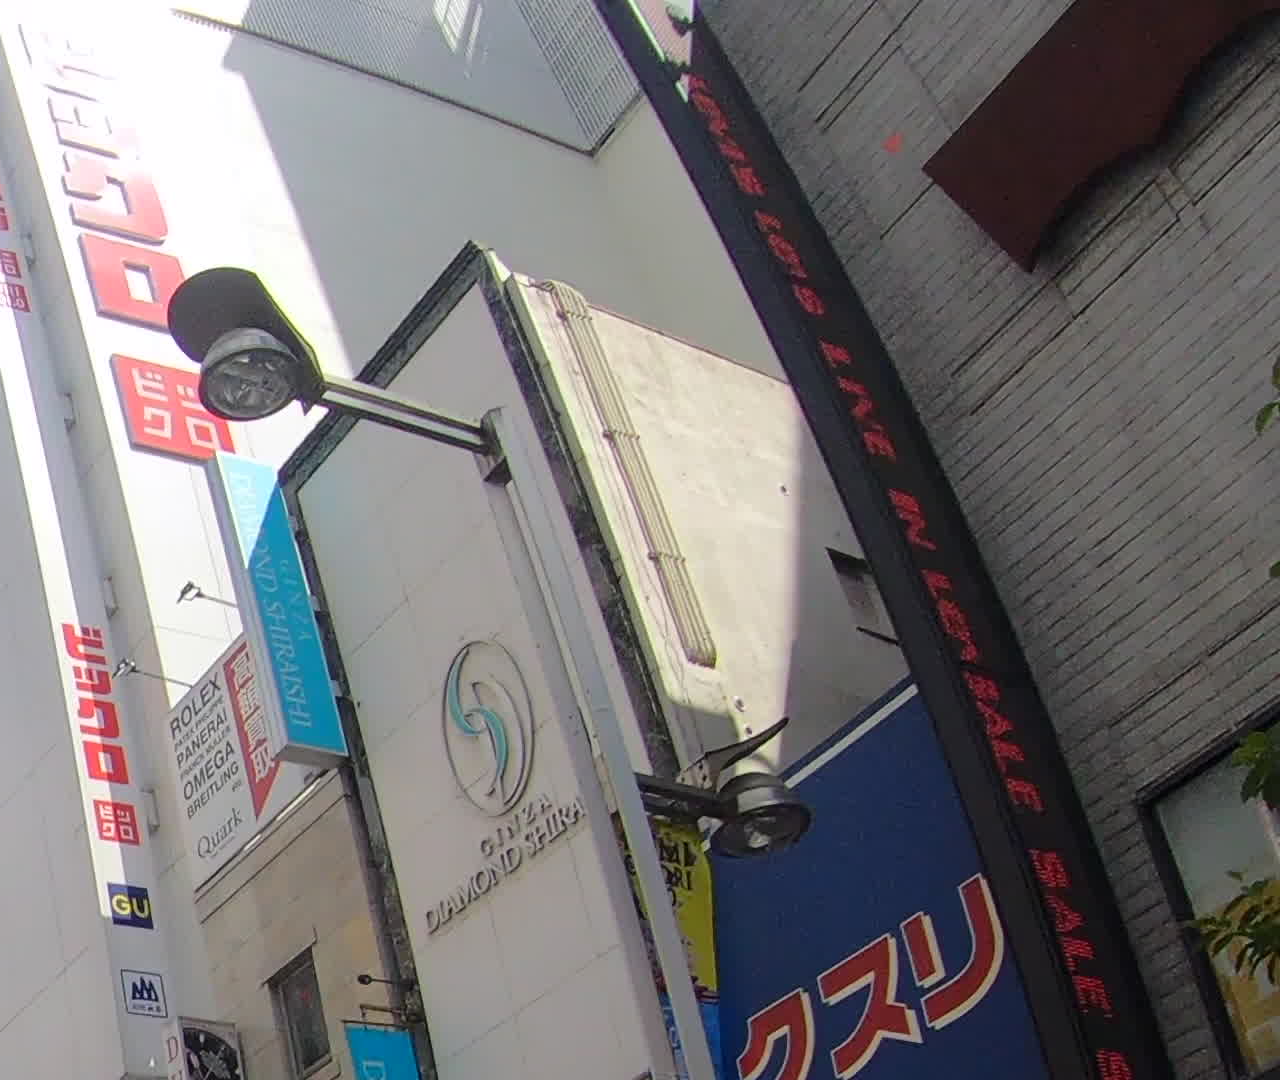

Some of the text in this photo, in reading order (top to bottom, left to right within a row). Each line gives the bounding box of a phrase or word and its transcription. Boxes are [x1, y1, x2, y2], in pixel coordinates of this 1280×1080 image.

[170, 672, 222, 740] ROLEX
[176, 708, 228, 768] PANERAI
[183, 741, 236, 800] OMEGA
[187, 761, 240, 820] BREITLING
[197, 808, 244, 859] Quark
[111, 895, 149, 918] GU
[425, 846, 523, 936] DIAMOND
[1032, 848, 1114, 1018] SALE
